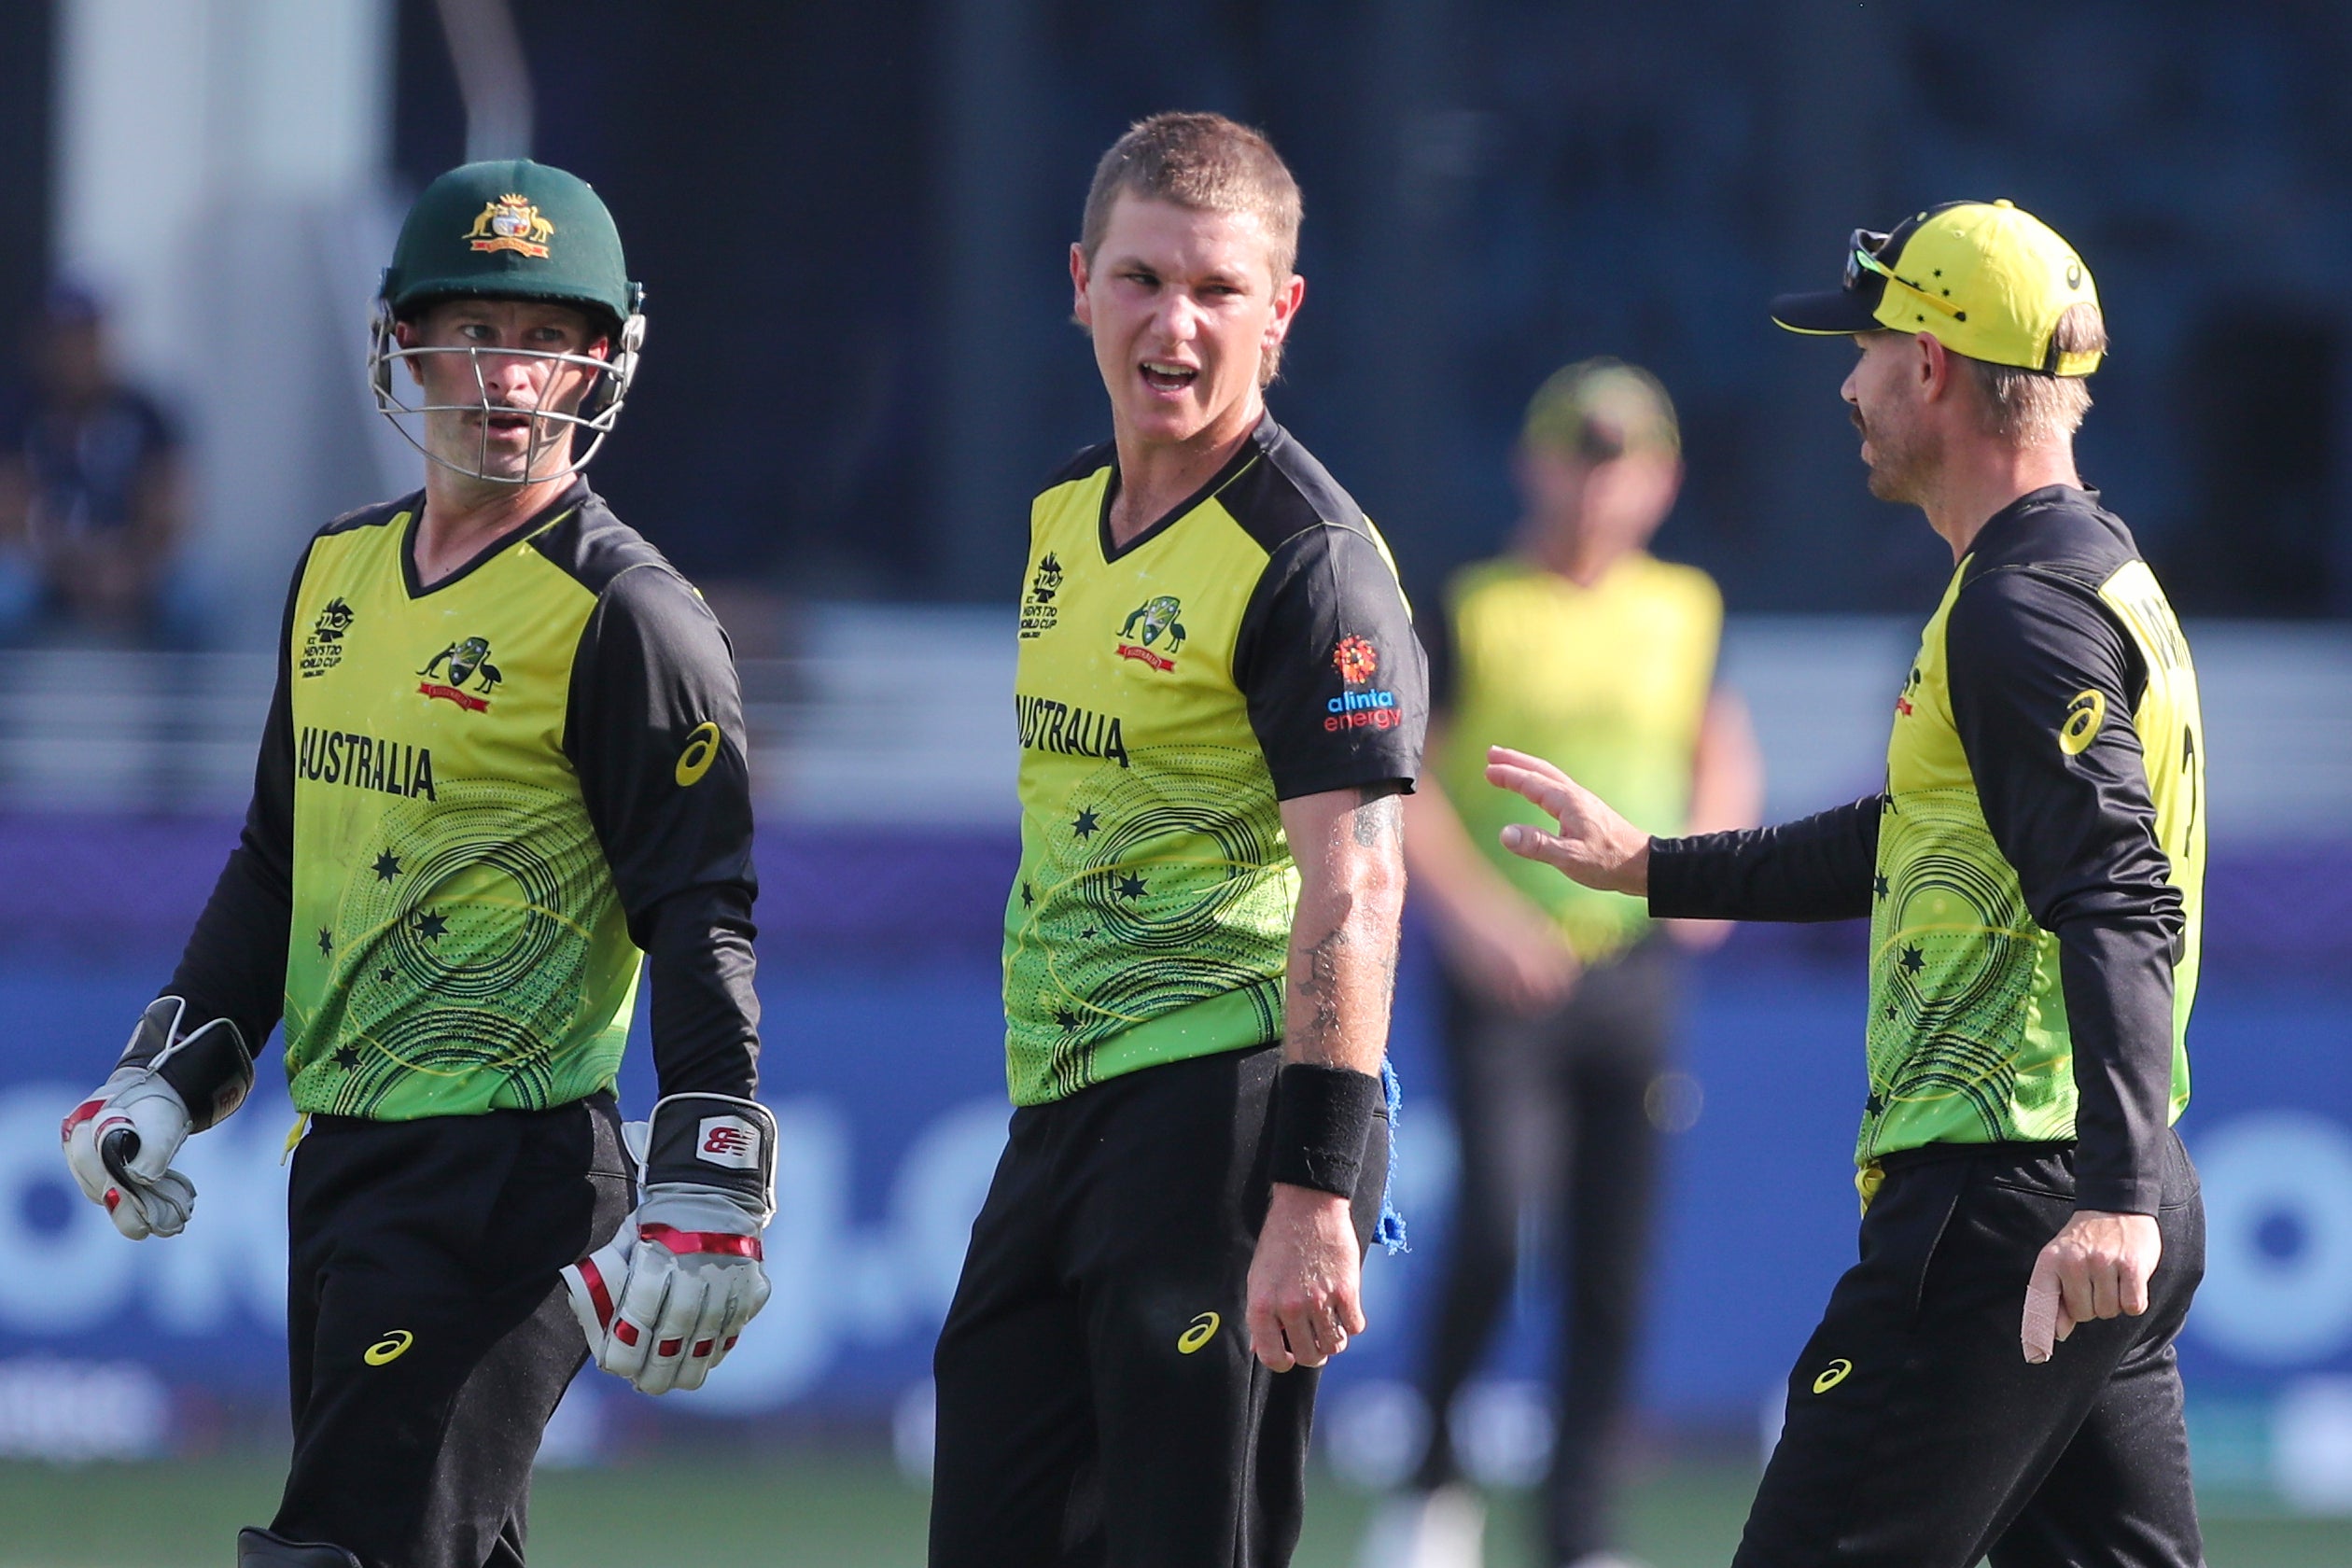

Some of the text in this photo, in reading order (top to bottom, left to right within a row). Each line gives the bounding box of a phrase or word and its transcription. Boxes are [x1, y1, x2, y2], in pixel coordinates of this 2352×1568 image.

[1042, 605, 1057, 618] T20
[1040, 618, 1057, 629] CUP
[326, 645, 342, 655] T20
[324, 657, 342, 668] CUP
[1327, 688, 1394, 714] alinta
[1324, 708, 1401, 732] energy
[299, 726, 438, 803] AUSTRALIA
